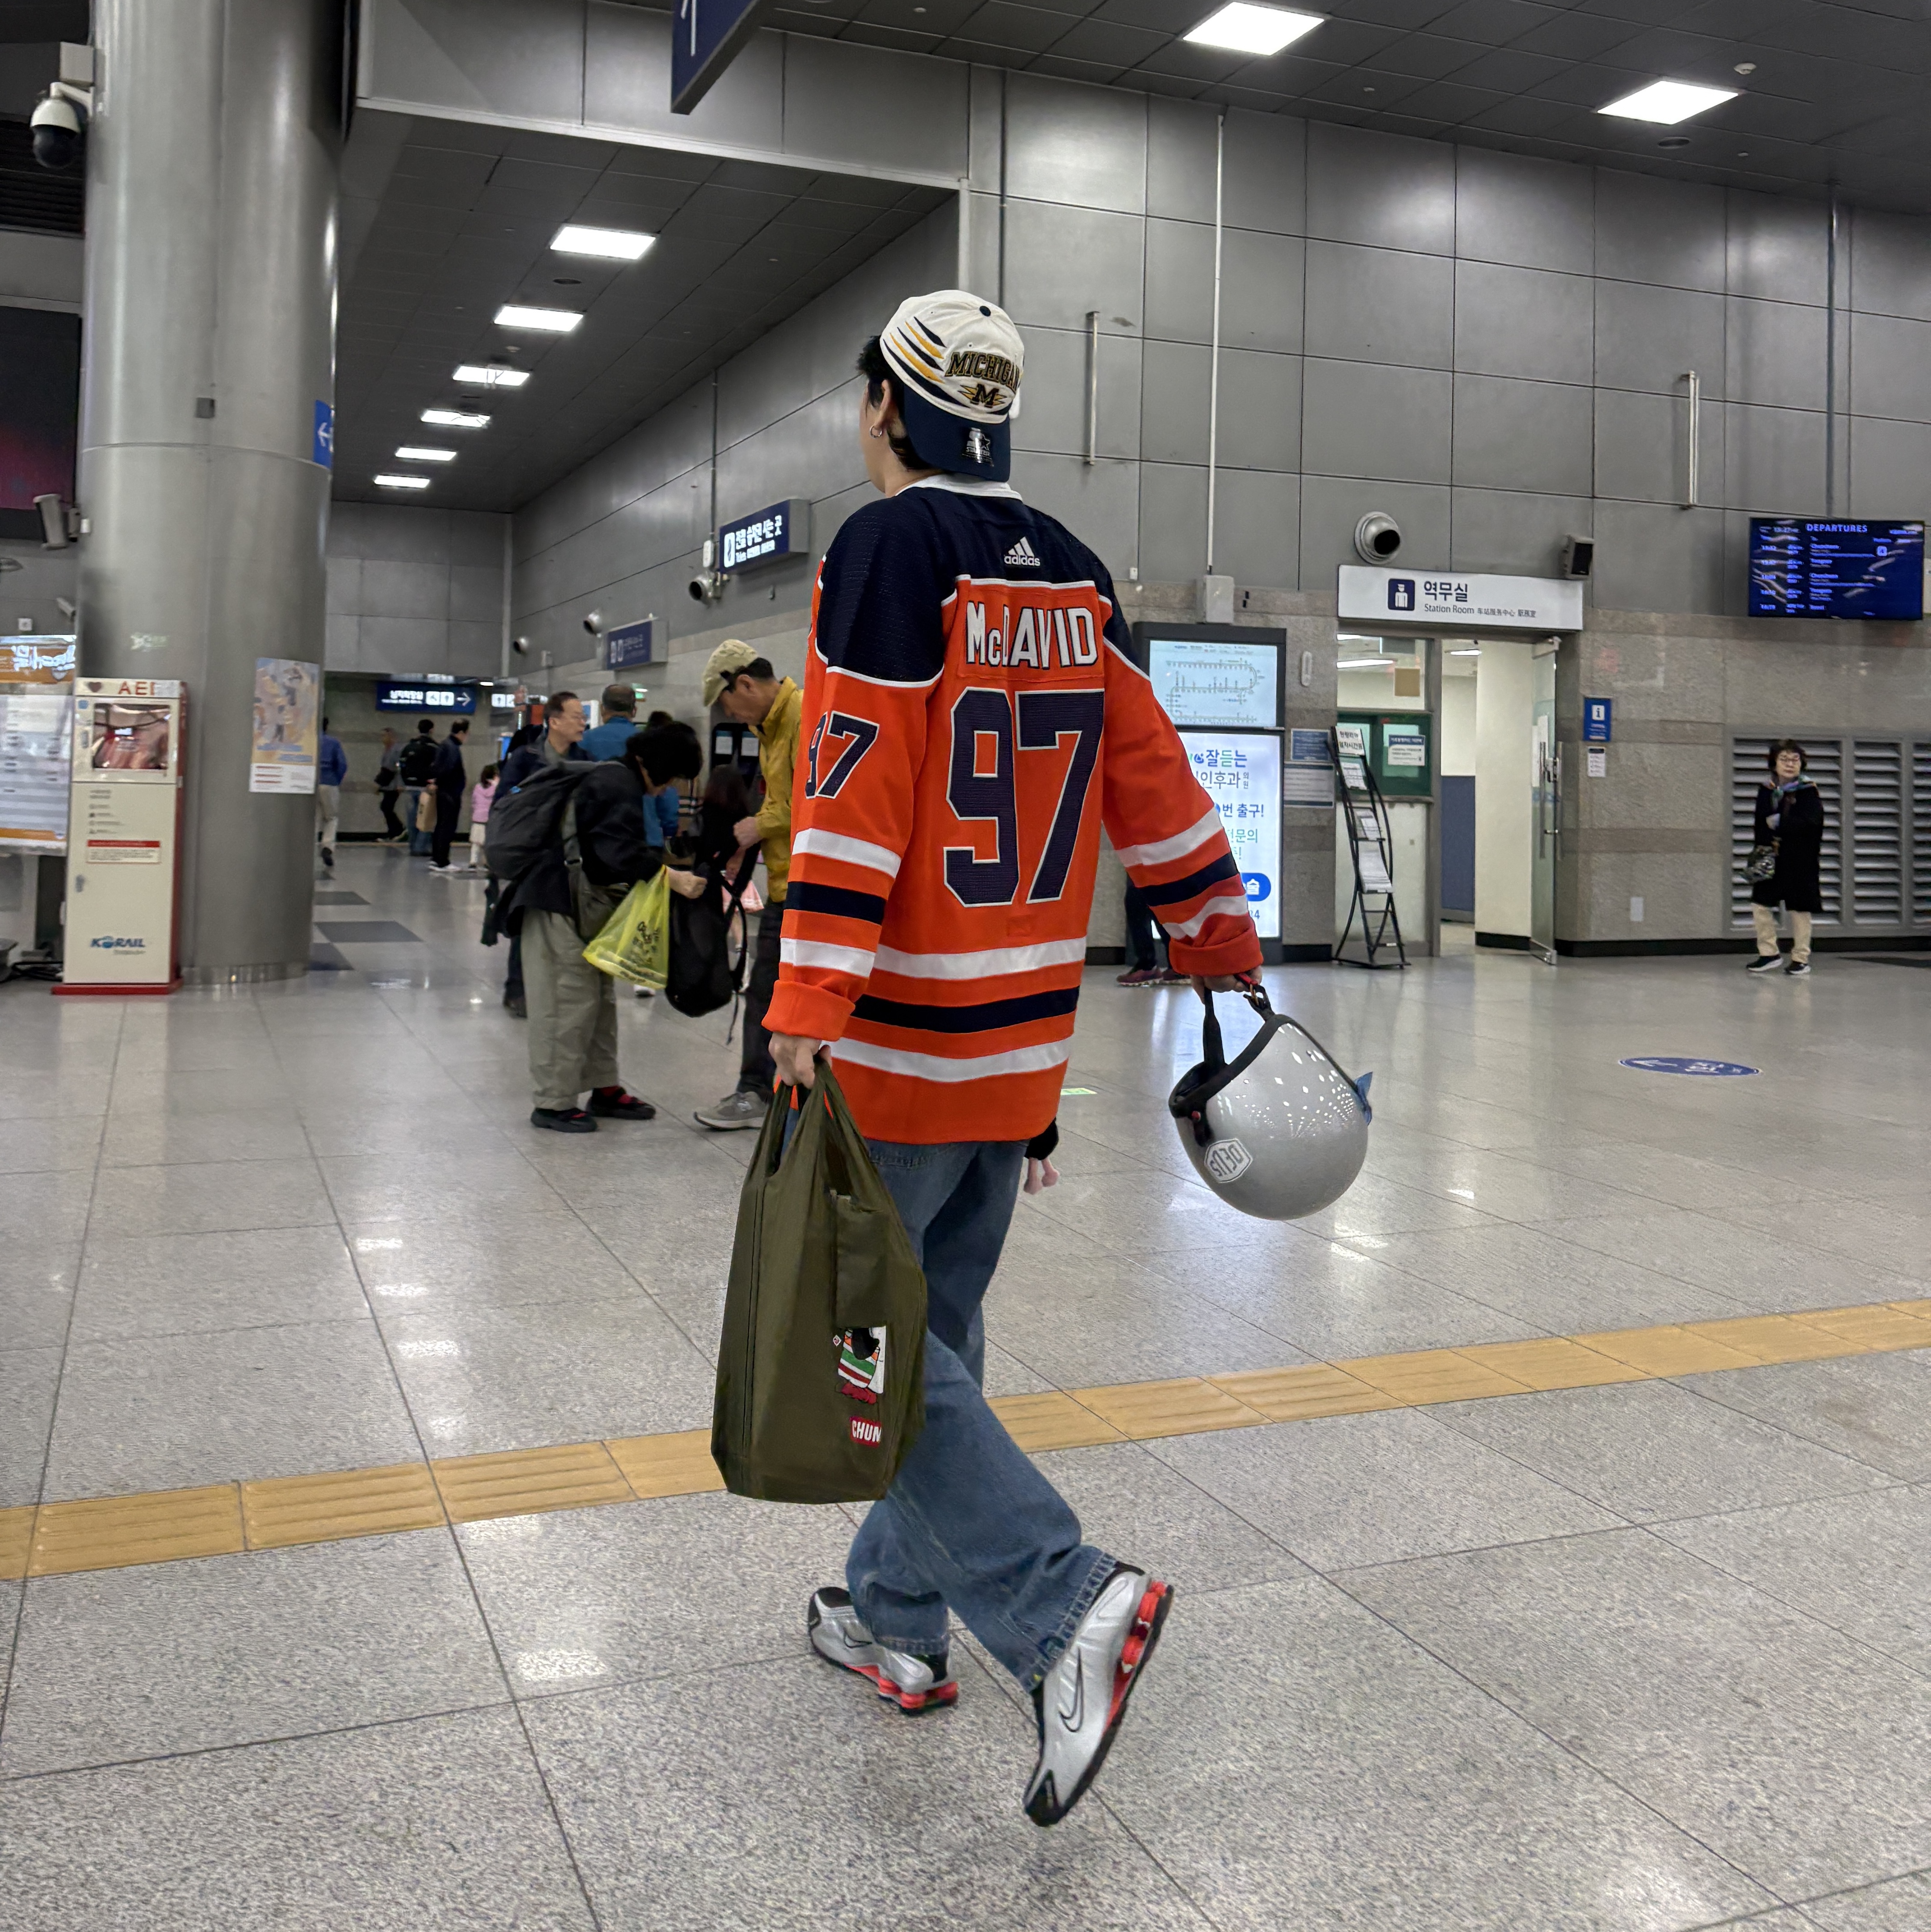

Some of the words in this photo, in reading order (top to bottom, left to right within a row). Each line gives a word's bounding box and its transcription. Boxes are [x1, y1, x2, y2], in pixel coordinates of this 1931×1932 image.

[1805, 523, 1867, 533] DEPARTURES
[1004, 554, 1041, 566] adidas
[1423, 580, 1468, 602] 역무실
[1424, 603, 1451, 614] Station
[1452, 605, 1474, 615] Room
[966, 600, 1098, 670] McDAVID
[805, 710, 880, 799] 97
[1196, 771, 1241, 789] 인후과
[943, 686, 1105, 908] 97
[1222, 803, 1233, 817] 번
[1237, 803, 1264, 818] 출구!
[1209, 1144, 1243, 1177] DEUS
